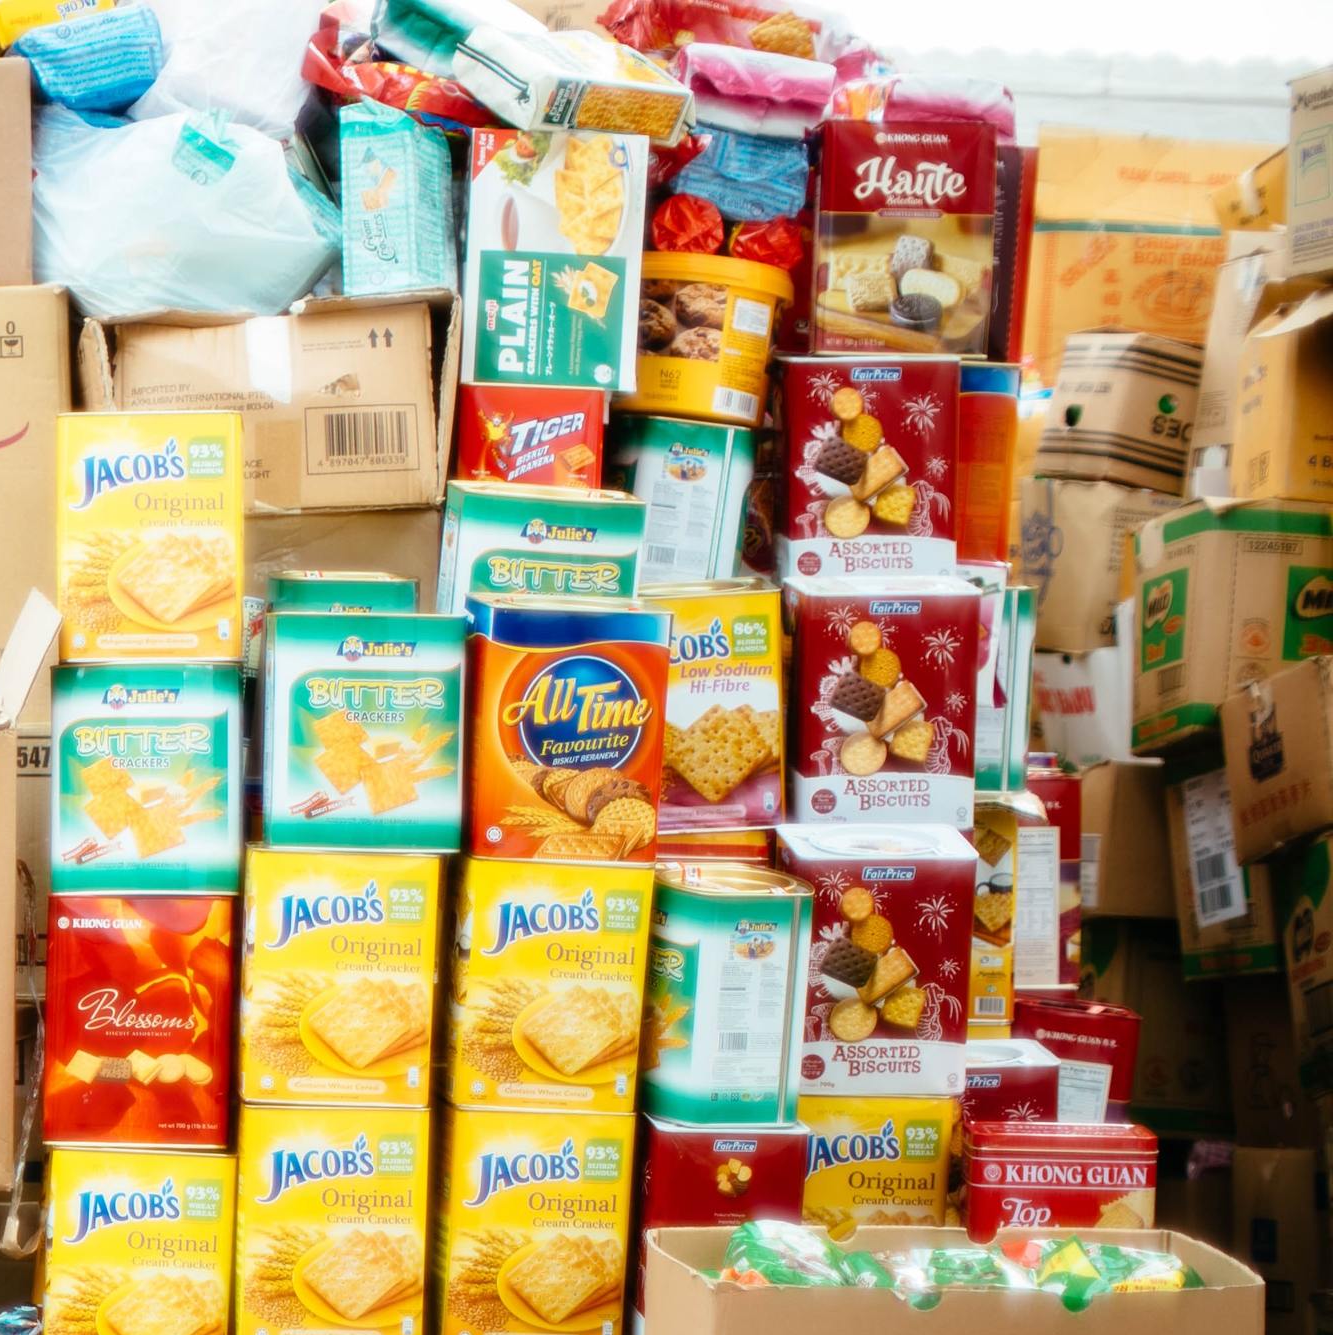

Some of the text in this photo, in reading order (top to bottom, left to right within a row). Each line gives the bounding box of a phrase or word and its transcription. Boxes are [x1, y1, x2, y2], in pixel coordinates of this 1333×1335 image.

[853, 155, 967, 205] Haute
[486, 299, 498, 331] meiji
[498, 259, 531, 374] PLAIN
[853, 368, 901, 380] FairPrice
[509, 411, 586, 457] TIGER
[515, 444, 551, 468] BISKUT
[69, 437, 185, 511] JACOB'S
[134, 491, 225, 517] Original
[547, 526, 594, 542] Julie's
[829, 542, 913, 558] ASSORTED
[489, 558, 621, 593] BUTTER
[844, 556, 914, 572] BISCUITS
[871, 601, 920, 614] FairPrice
[733, 623, 767, 637] 86%
[364, 642, 413, 658] Julie's
[680, 662, 773, 679] Low Sodium
[306, 677, 445, 710] BUTTER
[690, 679, 751, 694] Hi-Fibre
[502, 674, 654, 734] All Time
[345, 711, 405, 723] CRACKERS
[73, 725, 211, 757] BUTTER
[540, 733, 630, 757] Favourite
[111, 757, 169, 769] CRACKERS
[552, 751, 619, 767] BISKUT BERANEKA
[844, 778, 930, 797] ASSORTED
[859, 794, 931, 811] BISCUITS
[863, 867, 915, 880] FairPrice
[389, 888, 424, 904] 93%
[72, 918, 143, 929] KHONG GUAN
[265, 880, 384, 949] JACOB'S
[481, 888, 600, 956] JACOB'S
[330, 935, 422, 962] Original
[546, 942, 636, 969] Original
[335, 961, 422, 974] Cream Cracker
[77, 988, 197, 1030] Blossoms
[832, 1045, 921, 1062] ASSORTED
[847, 1059, 922, 1077] BISCUITS
[256, 1133, 374, 1203] JACOB'S
[464, 1137, 581, 1208] JACOB'S
[1006, 1165, 1147, 1185] KHONG GUAN
[848, 1170, 936, 1197] Original
[64, 1177, 180, 1244] JACOB'S
[322, 1188, 413, 1215] Original
[527, 1192, 617, 1219] Original
[127, 1230, 218, 1257] Original
